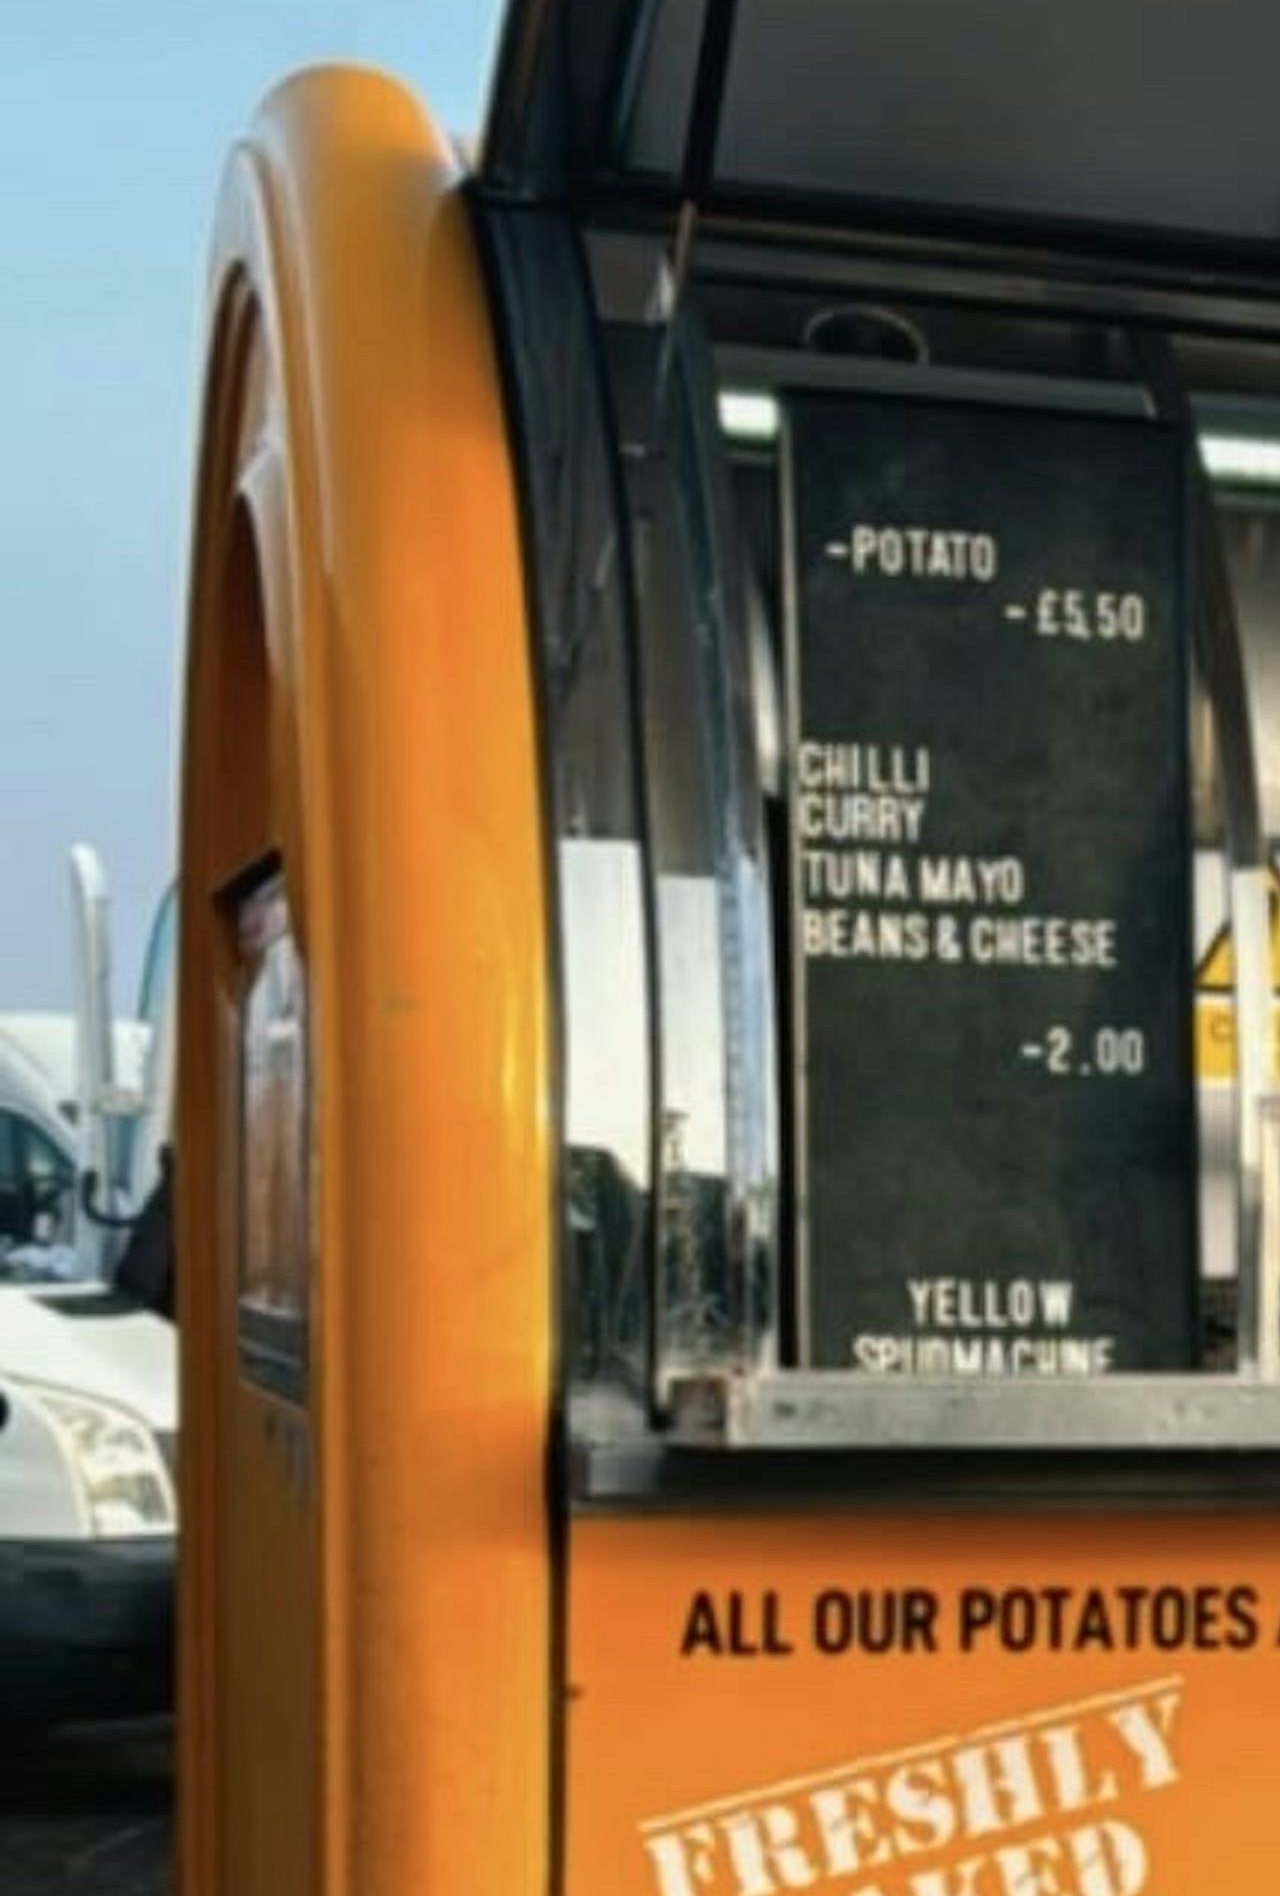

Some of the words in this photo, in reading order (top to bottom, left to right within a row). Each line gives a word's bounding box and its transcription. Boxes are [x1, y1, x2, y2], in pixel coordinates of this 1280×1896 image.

[800, 741, 930, 794] CHILLI
[800, 793, 925, 843] CURRY
[805, 849, 910, 899] TUNA
[919, 856, 1024, 904] MAYO
[803, 907, 931, 960] BEANS
[936, 915, 962, 962] &
[969, 917, 1118, 969] CHEESE
[906, 1277, 1073, 1328] YELLOW
[681, 1590, 793, 1656] ALL
[813, 1589, 940, 1654] OUR
[959, 1586, 1258, 1653] POTATOES
